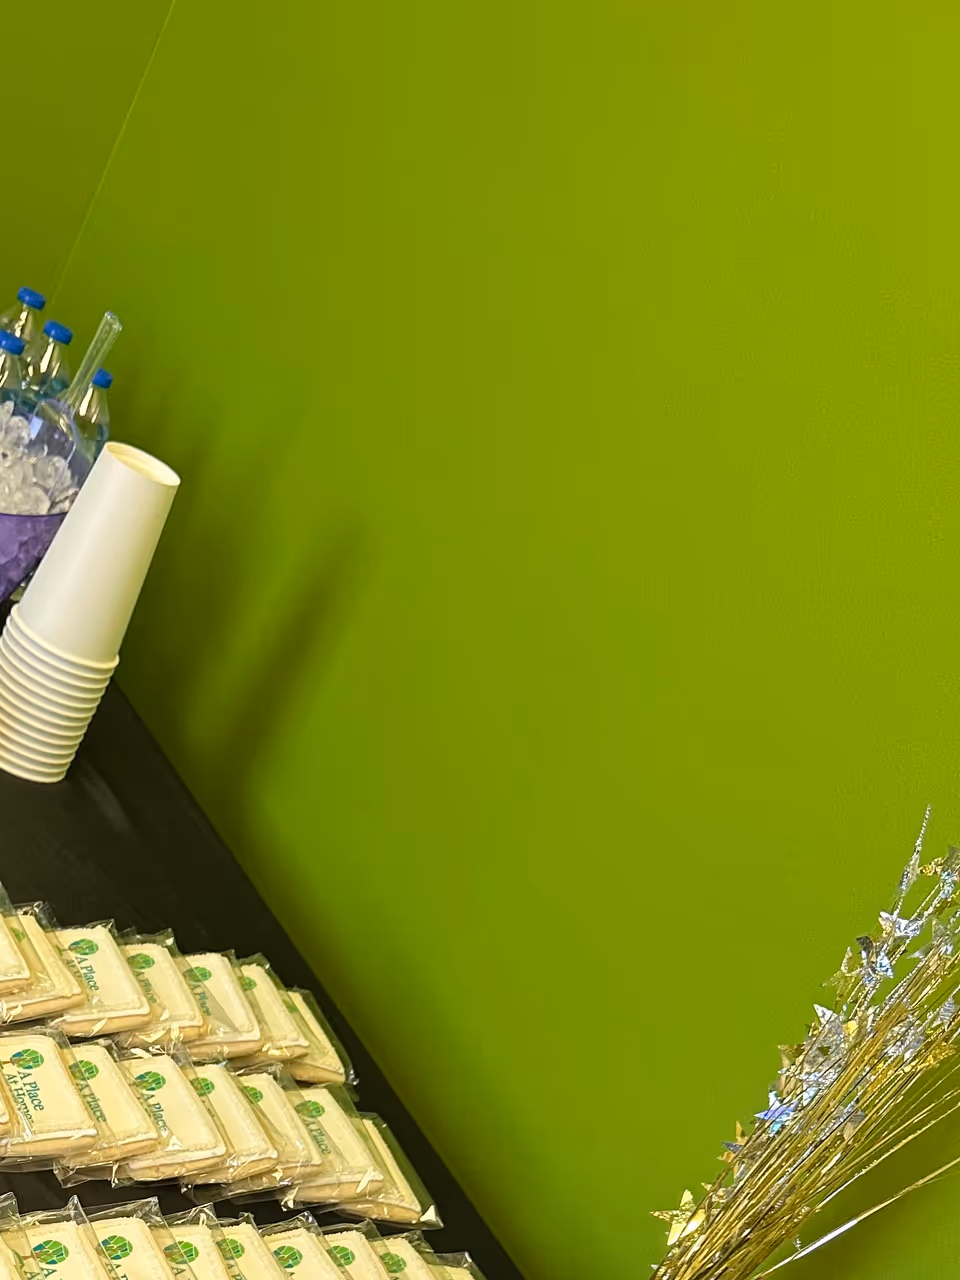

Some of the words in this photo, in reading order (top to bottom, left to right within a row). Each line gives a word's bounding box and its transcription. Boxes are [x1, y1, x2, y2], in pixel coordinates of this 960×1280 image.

[75, 951, 88, 964] A
[79, 964, 99, 991] Place
[17, 1065, 31, 1080] A
[75, 1078, 90, 1092] A
[22, 1080, 44, 1110] Place
[141, 1088, 155, 1102] A
[82, 1092, 106, 1122] Place
[302, 1114, 316, 1128] A
[308, 1125, 331, 1155] Place
[39, 1261, 57, 1278] A
[170, 1260, 185, 1276] A
